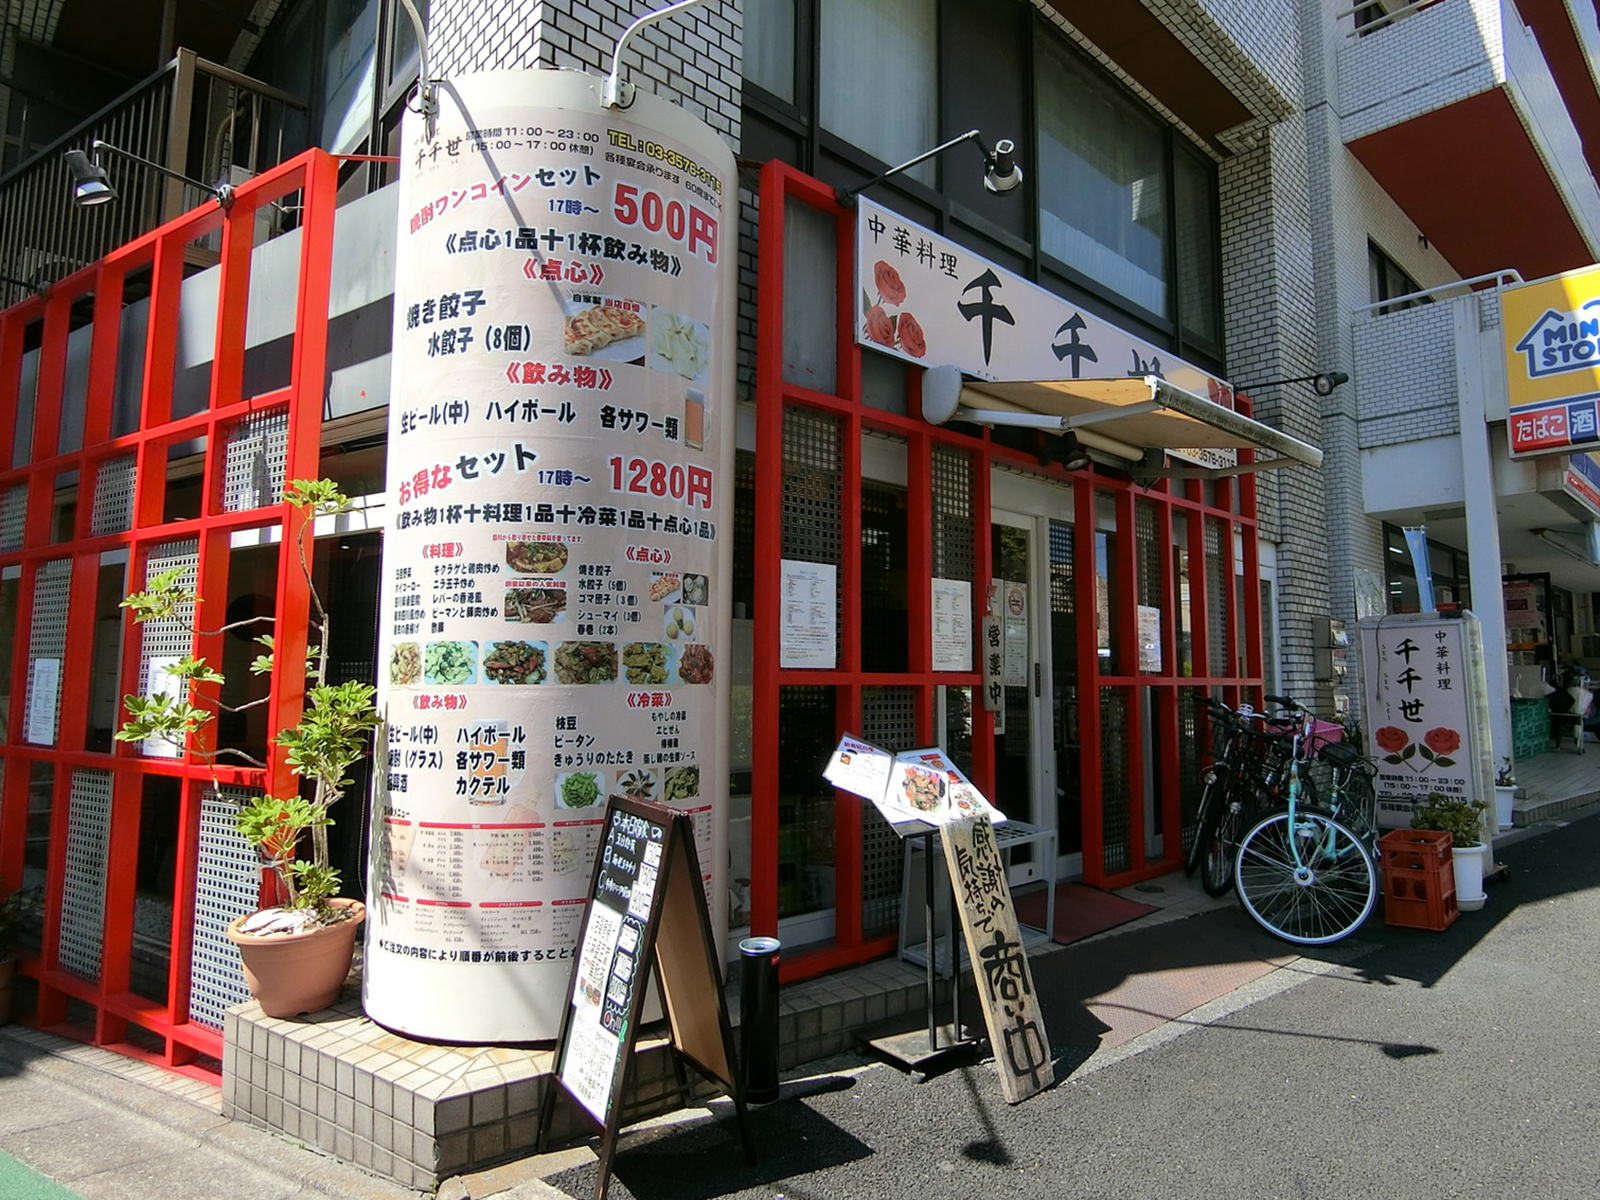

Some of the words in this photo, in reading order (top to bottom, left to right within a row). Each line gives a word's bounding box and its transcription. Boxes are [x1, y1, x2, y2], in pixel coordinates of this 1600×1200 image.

[415, 136, 462, 170] 千千世
[605, 152, 680, 184] 各種宴会承ります
[548, 198, 600, 216] 17時～
[613, 183, 719, 264] 500円
[867, 213, 959, 281] 中華料理
[522, 259, 604, 286] 《点心》
[406, 290, 486, 331] 焼き餃子
[1542, 337, 1600, 367] STO
[506, 362, 613, 390] 《飲み物》
[400, 399, 470, 434] 生ビール(中)
[485, 399, 576, 424] ハイボール
[601, 404, 679, 441] 各サワー類
[1516, 414, 1566, 443] たばこ
[1571, 408, 1595, 435] 酒
[398, 443, 537, 505] お得なセット
[538, 469, 591, 486] 17時～
[609, 456, 712, 509] 1280円
[422, 541, 464, 559] 《料理》
[626, 546, 672, 564] 《点心》
[579, 565, 612, 577] 焼き餃子
[988, 624, 1002, 705] 営業中
[1434, 629, 1452, 691] 中華料理
[1394, 637, 1425, 723] 千千世
[413, 694, 468, 710] 《飲み物》
[627, 692, 672, 708] 《冷菜》
[456, 725, 526, 745] ハイボール
[556, 716, 577, 731] 枝豆
[554, 734, 596, 748] ピータン
[456, 750, 526, 770] 各サワー類
[554, 751, 634, 767] きゅうりのたたき
[456, 776, 510, 796] カクテル
[603, 845, 612, 863] B
[971, 817, 1006, 913] 感謝の
[955, 844, 995, 933] 気持ちで
[979, 930, 1047, 1090] 商い中
